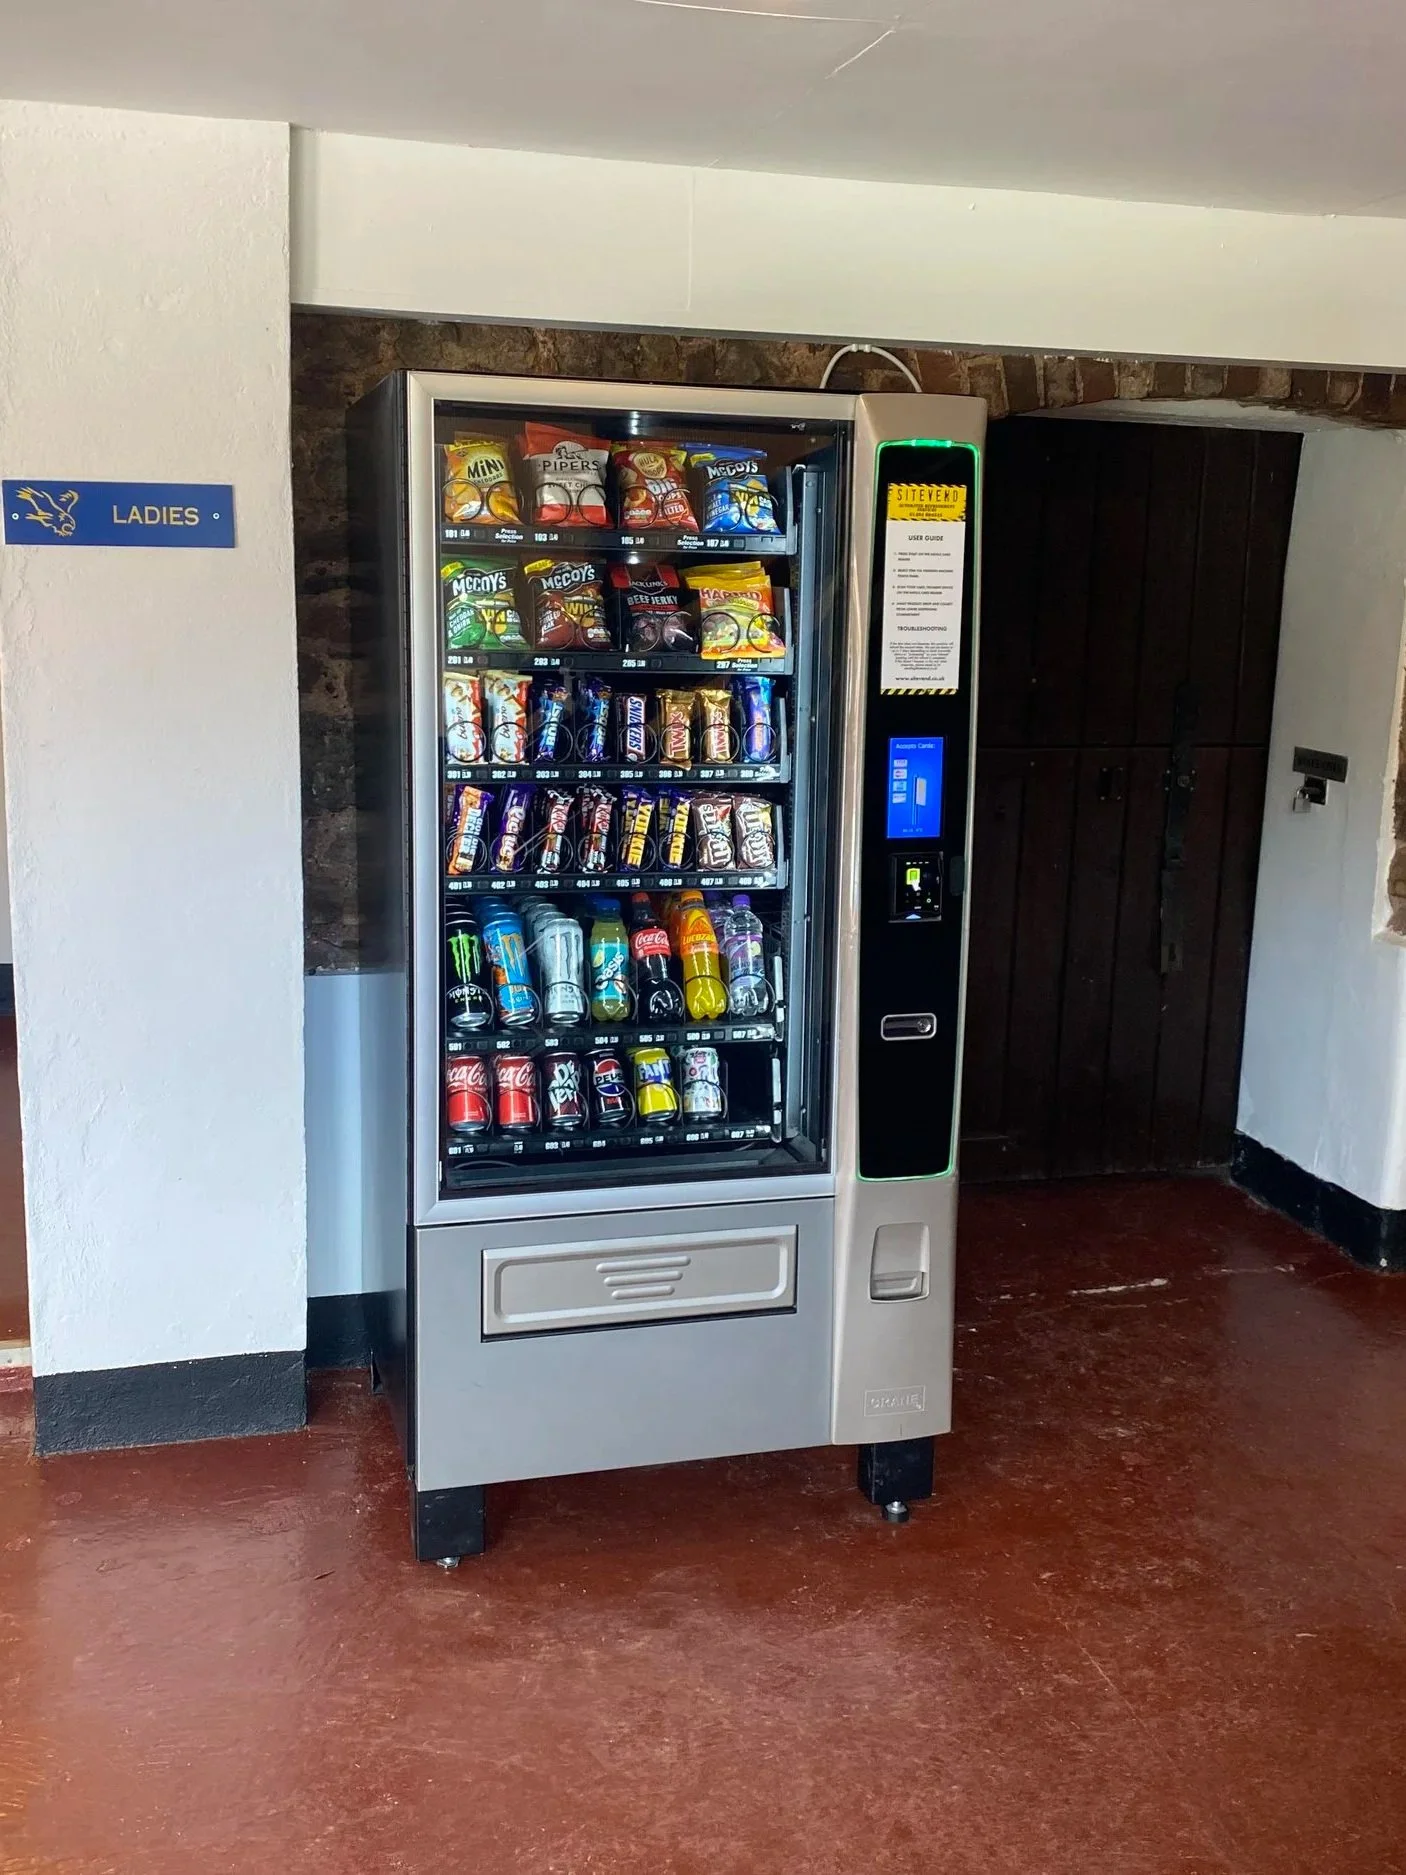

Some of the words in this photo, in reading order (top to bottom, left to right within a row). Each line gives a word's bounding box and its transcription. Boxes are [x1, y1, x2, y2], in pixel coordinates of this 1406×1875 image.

[542, 460, 600, 471] PIPERS
[897, 489, 958, 502] SITEVEND
[112, 505, 200, 526] LADIES
[534, 533, 548, 542] 103
[627, 595, 651, 605] BEEF
[650, 595, 678, 605] JERKY
[628, 698, 643, 751] SNICKERS
